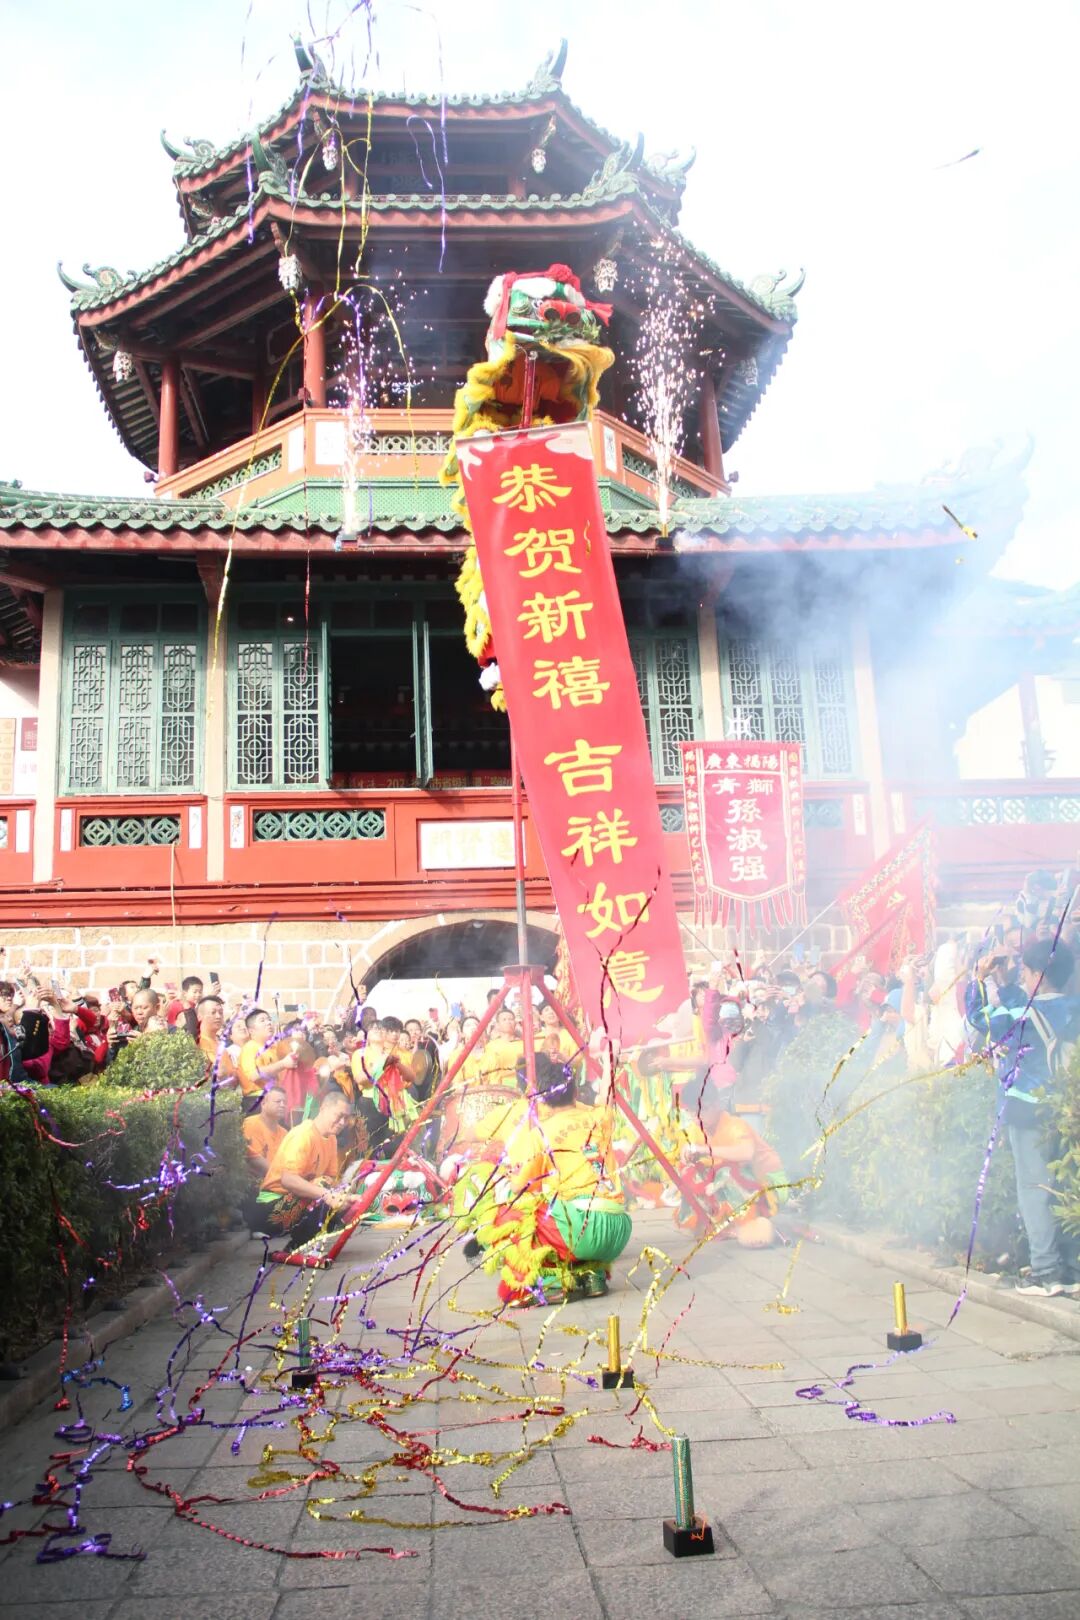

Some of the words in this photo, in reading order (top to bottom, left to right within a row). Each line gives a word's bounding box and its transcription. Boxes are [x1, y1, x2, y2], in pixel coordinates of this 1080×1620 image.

[492, 464, 611, 710] 恭贺新禧
[543, 739, 664, 1009] 吉祥如意
